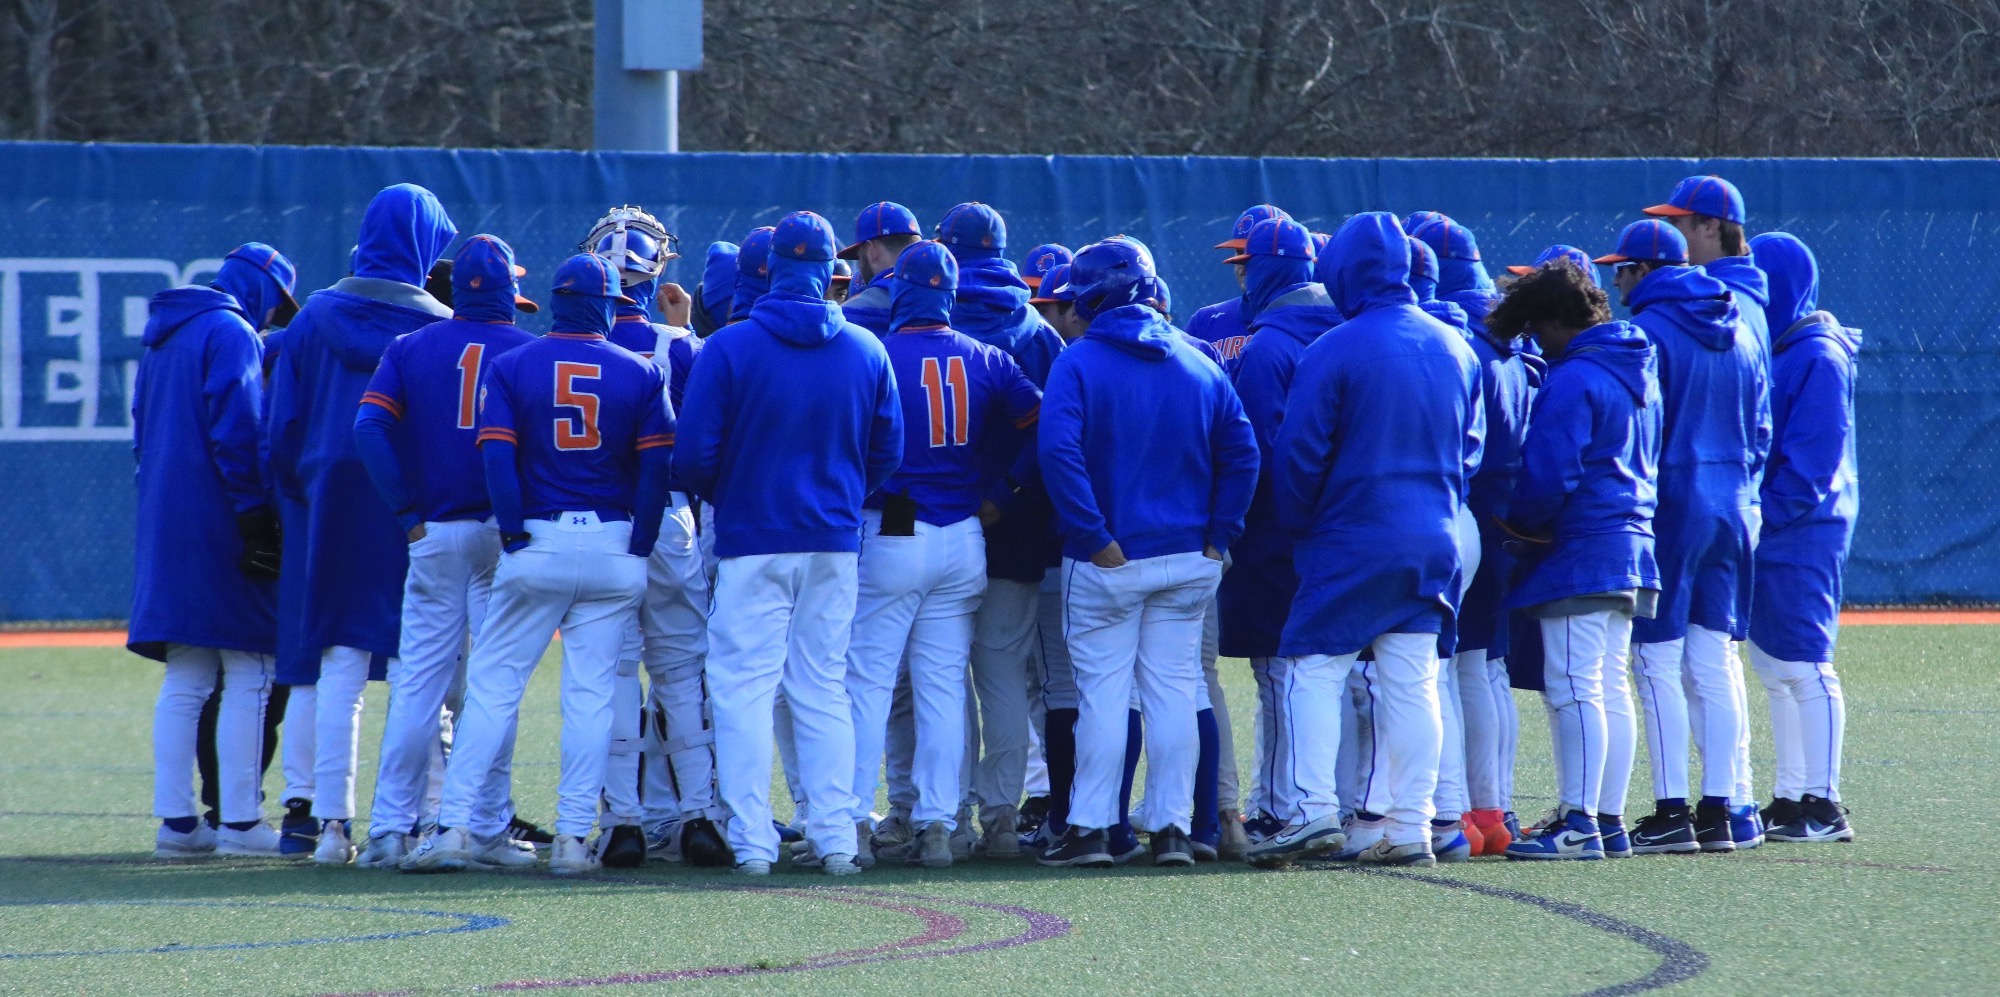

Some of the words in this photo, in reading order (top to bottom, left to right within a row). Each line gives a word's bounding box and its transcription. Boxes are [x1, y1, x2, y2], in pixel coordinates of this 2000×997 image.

[0, 258, 226, 441] ER
[457, 343, 485, 429] 1
[1212, 335, 1253, 360] UR
[554, 361, 601, 451] 5
[921, 356, 969, 448] 11
